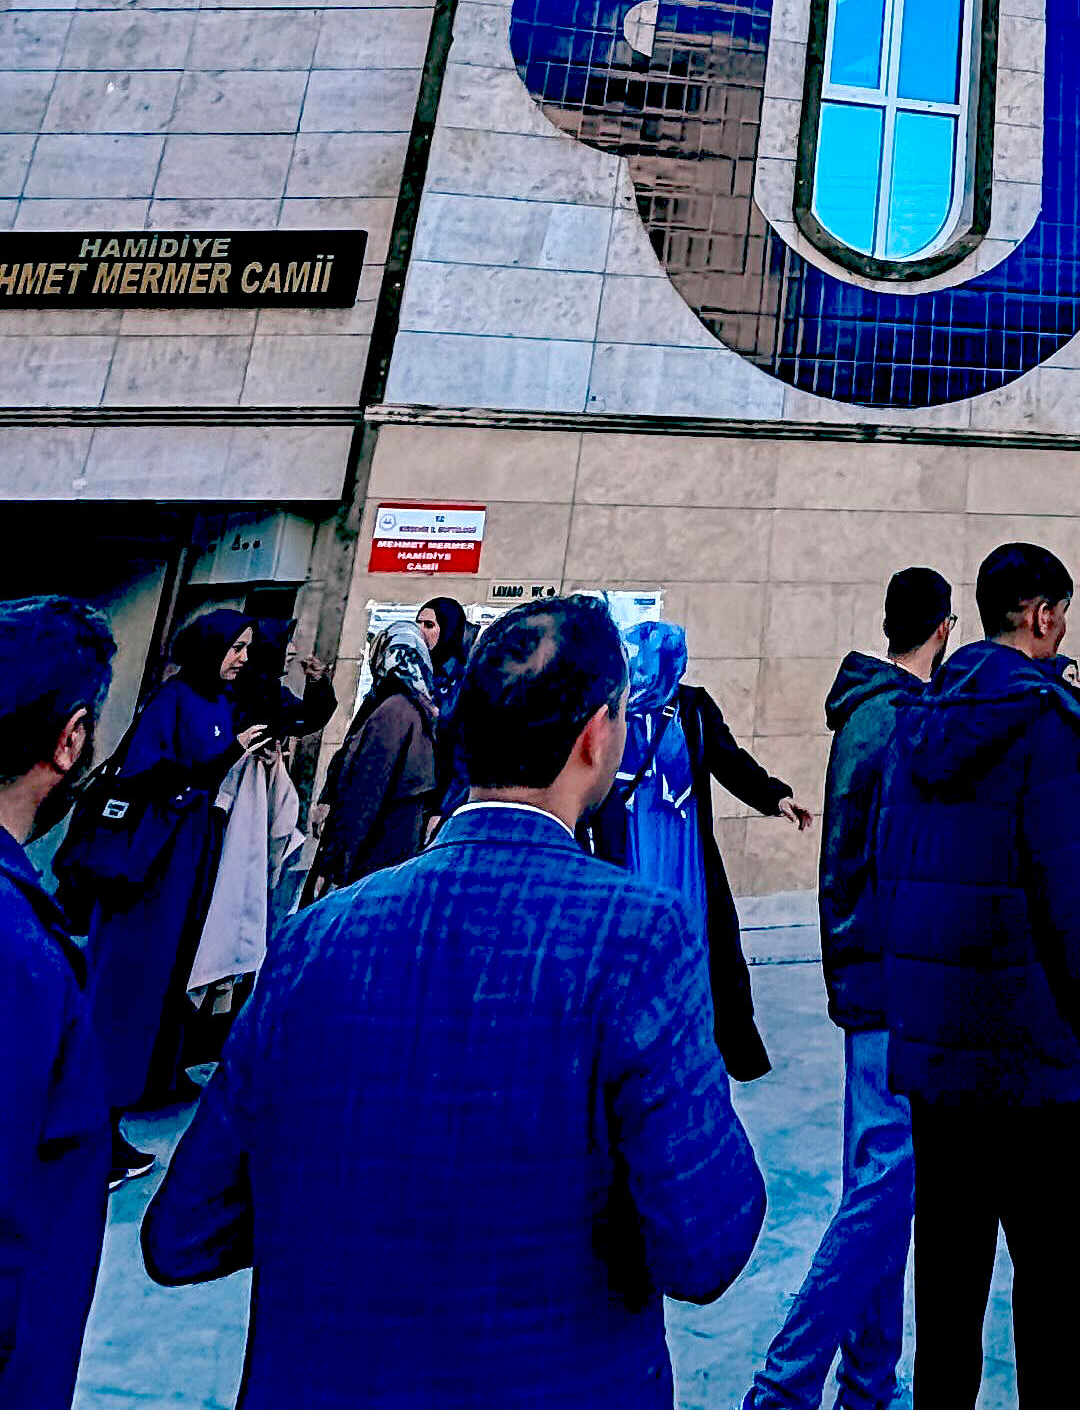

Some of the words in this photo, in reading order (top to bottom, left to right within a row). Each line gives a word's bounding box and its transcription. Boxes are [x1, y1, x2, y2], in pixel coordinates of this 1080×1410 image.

[78, 233, 232, 258] HAMİDİYE
[92, 262, 232, 294] MERMER
[241, 254, 335, 294] CAMİİ
[376, 540, 426, 549] MEHMET
[427, 542, 475, 550] MERMER
[397, 551, 452, 561] HAMİDİYE
